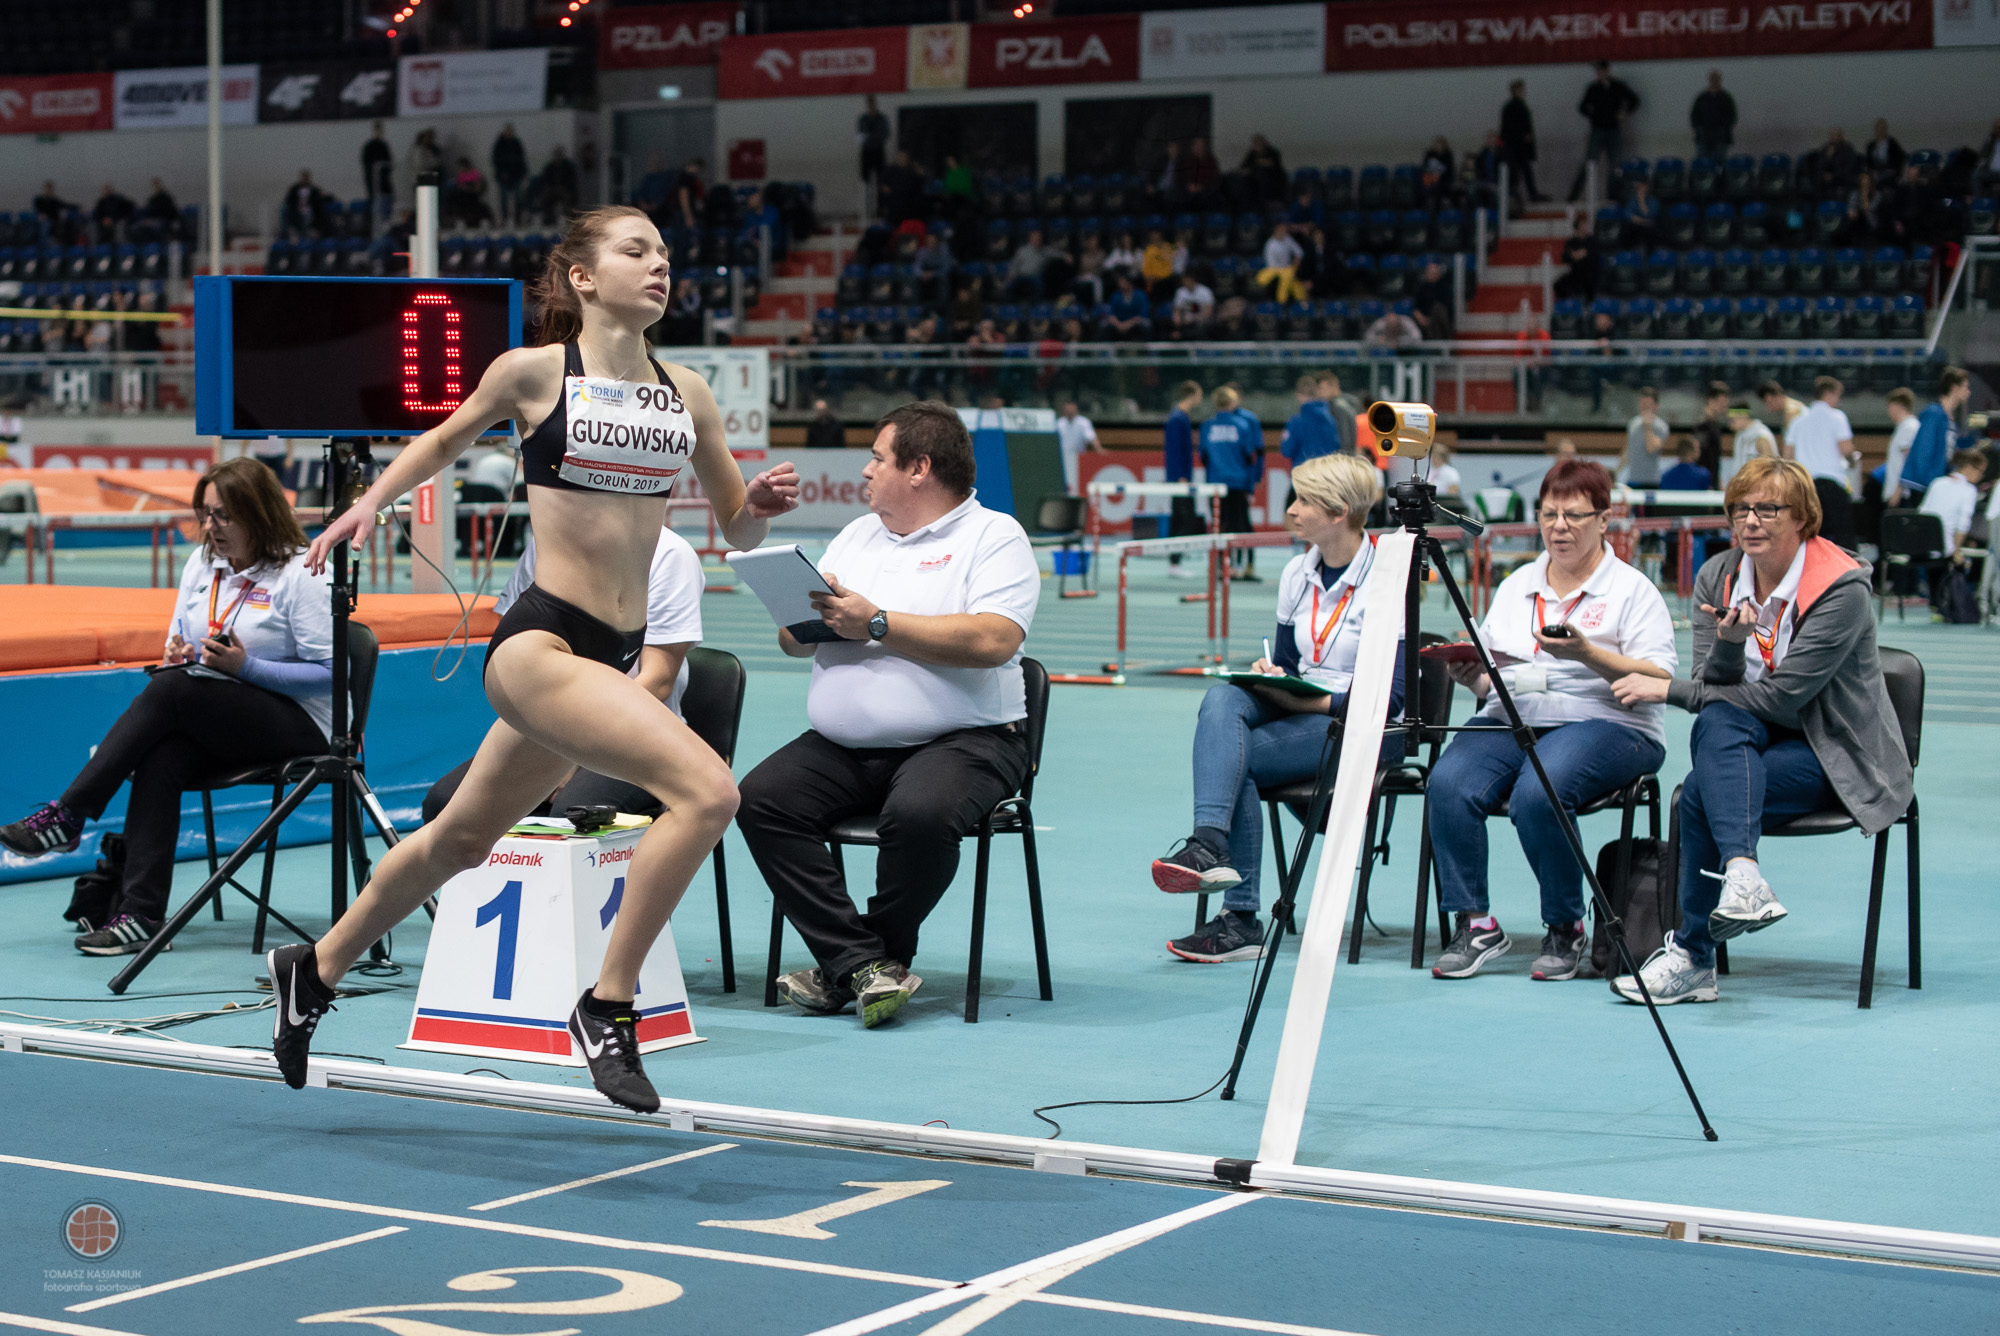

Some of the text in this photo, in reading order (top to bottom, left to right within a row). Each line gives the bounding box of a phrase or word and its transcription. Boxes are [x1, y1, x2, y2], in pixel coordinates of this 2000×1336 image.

[1344, 21, 1457, 48] POLSKI
[1465, 14, 1611, 44] ZWIĄZEK
[1617, 8, 1749, 37] LEKKIEJ
[1757, 1, 1911, 31] ATLETYKI
[996, 34, 1111, 70] PZLA
[267, 73, 320, 111] 4F
[340, 69, 391, 107] 4F
[404, 294, 460, 411] 0
[590, 385, 624, 399] TORUŃ
[636, 386, 685, 414] 905
[572, 418, 688, 456] GUZOWSKA
[725, 410, 762, 434] 60
[584, 461, 607, 470] HALOWE
[607, 465, 645, 474] MISTRZOSTWA
[645, 468, 663, 476] POLSKI
[586, 473, 630, 489] TORUŃ
[632, 478, 661, 491] 2019
[488, 851, 544, 867] polanik
[475, 880, 523, 1001] 1
[698, 1179, 954, 1240] 1
[296, 1265, 684, 1336] 2
